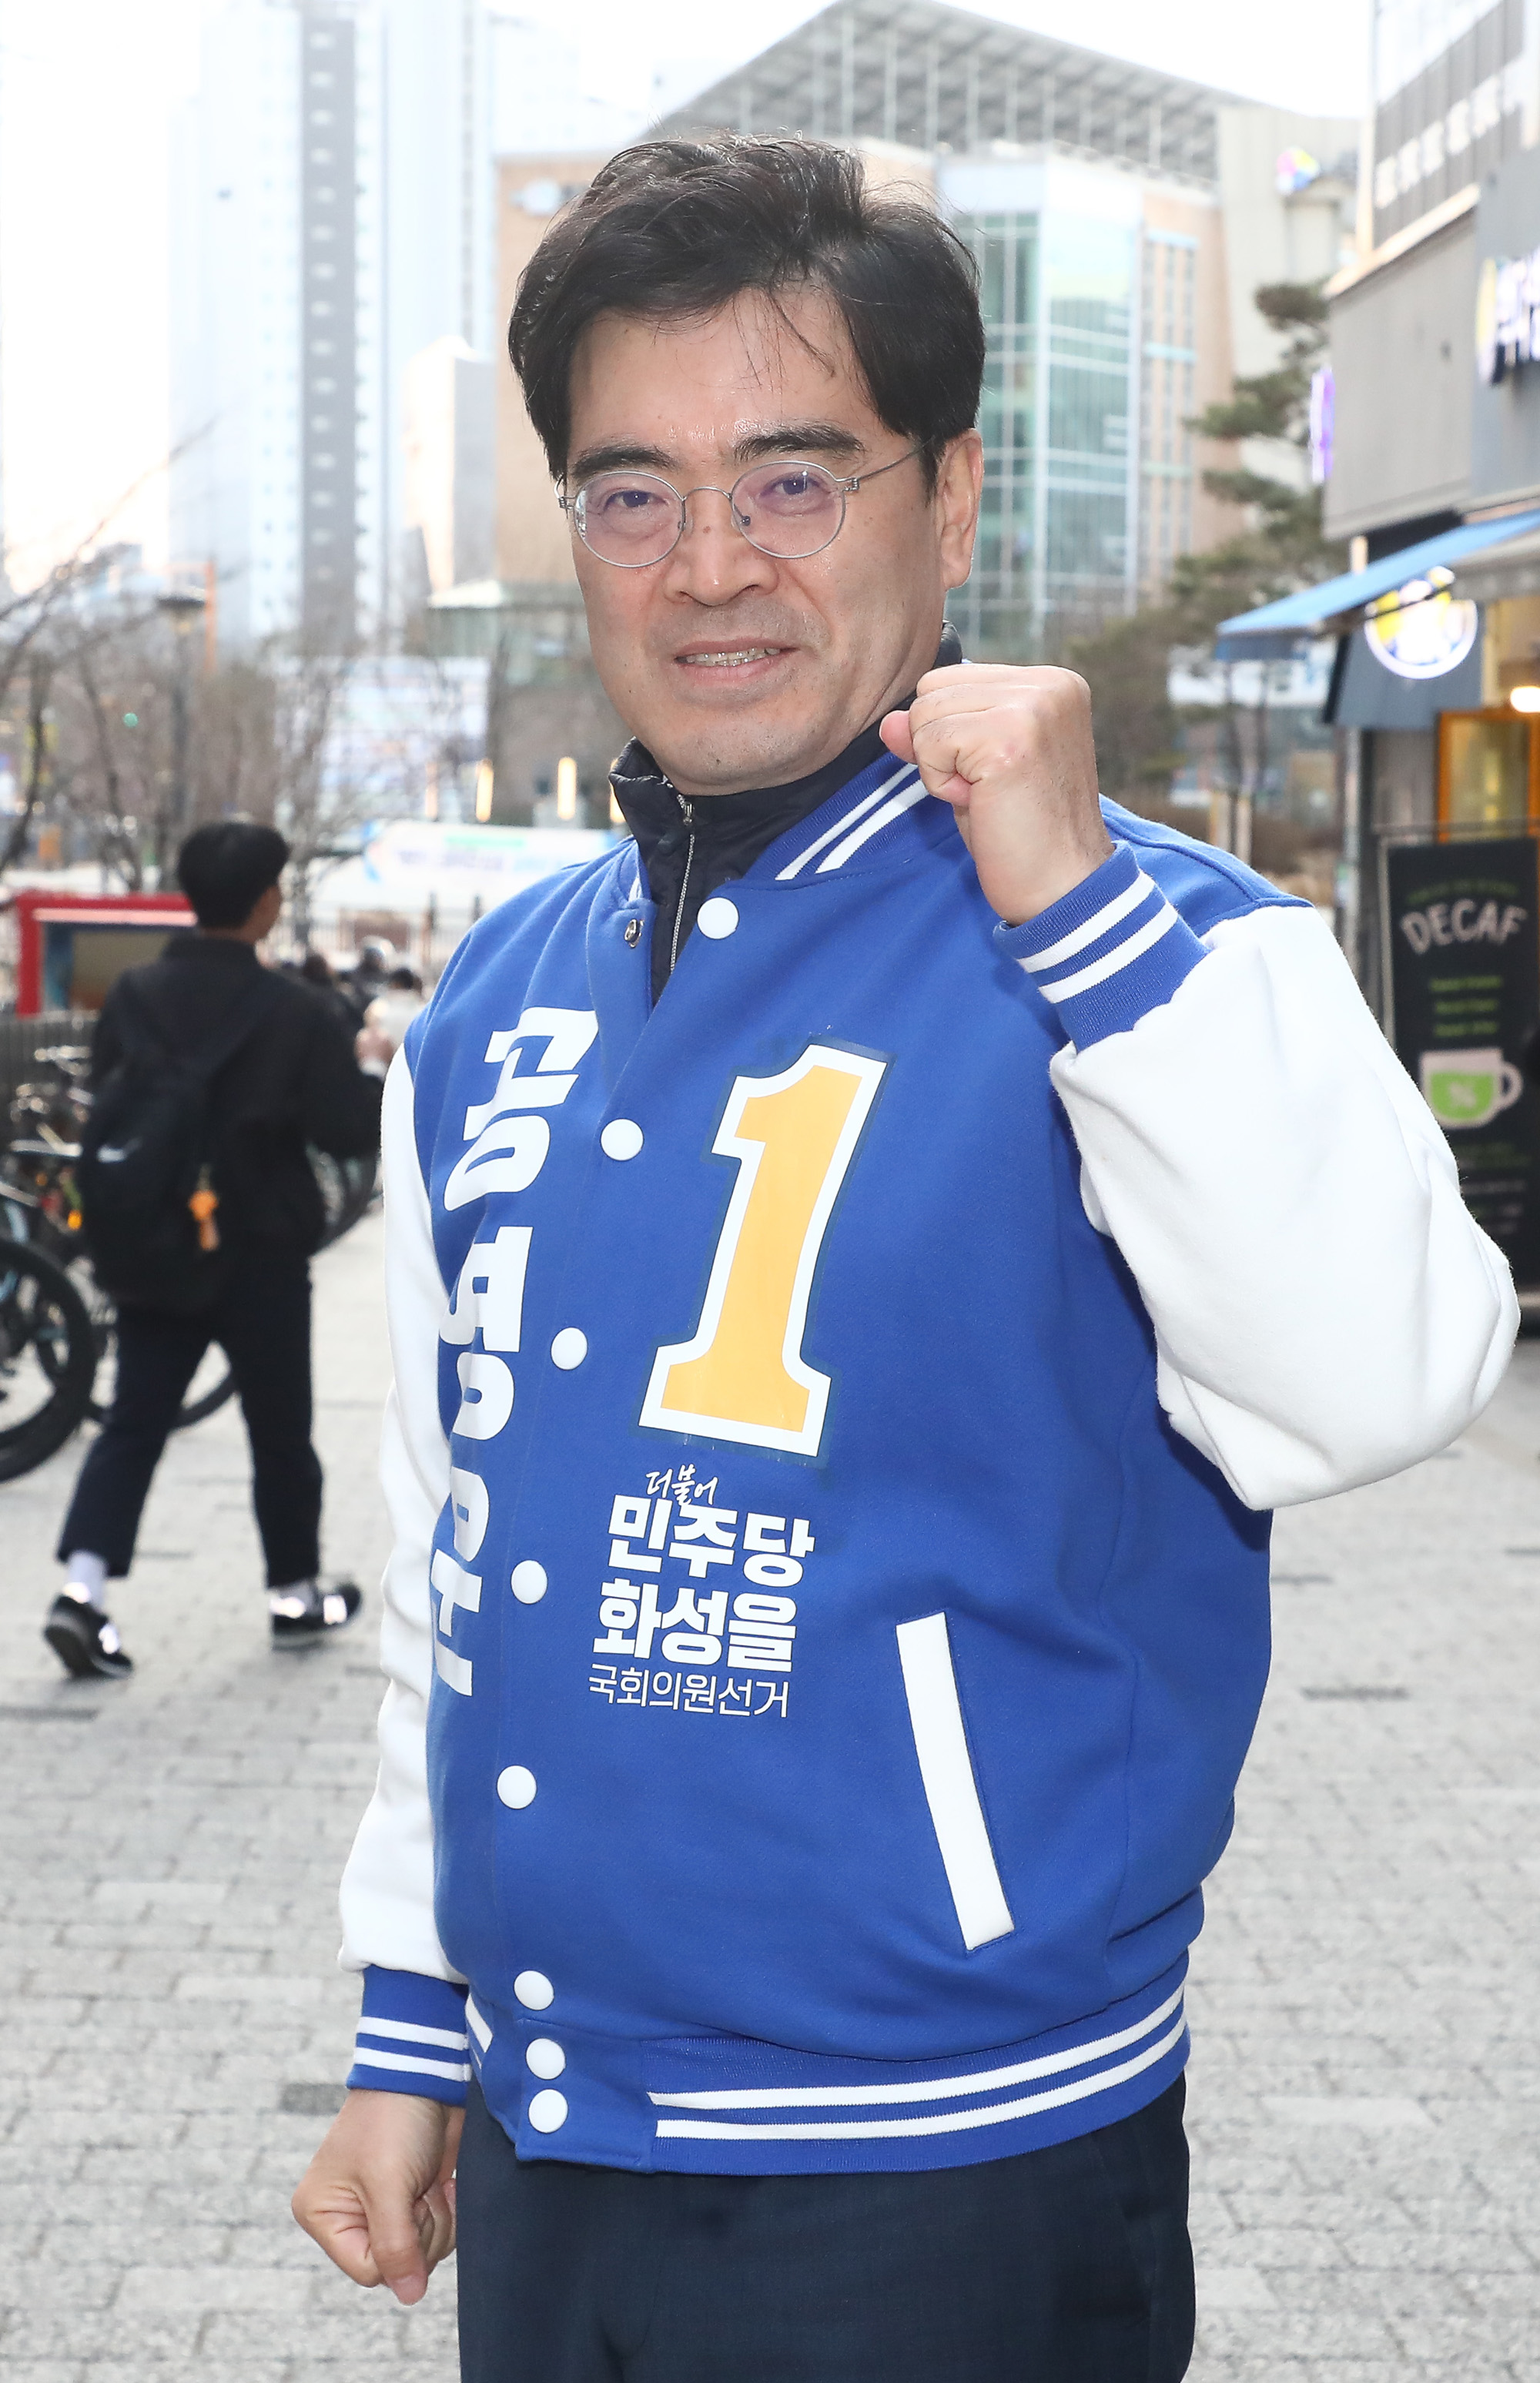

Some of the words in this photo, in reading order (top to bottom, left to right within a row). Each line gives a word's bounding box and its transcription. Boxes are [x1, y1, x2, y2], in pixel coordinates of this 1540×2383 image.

[1400, 898, 1528, 955] DECAF
[638, 1044, 888, 1457] 1
[428, 1006, 600, 1697] 공영운
[645, 1463, 718, 1507] 더불어
[608, 1494, 815, 1588] 민주당
[592, 1578, 798, 1672] 화성을
[588, 1663, 789, 1718] 국회의원선거
